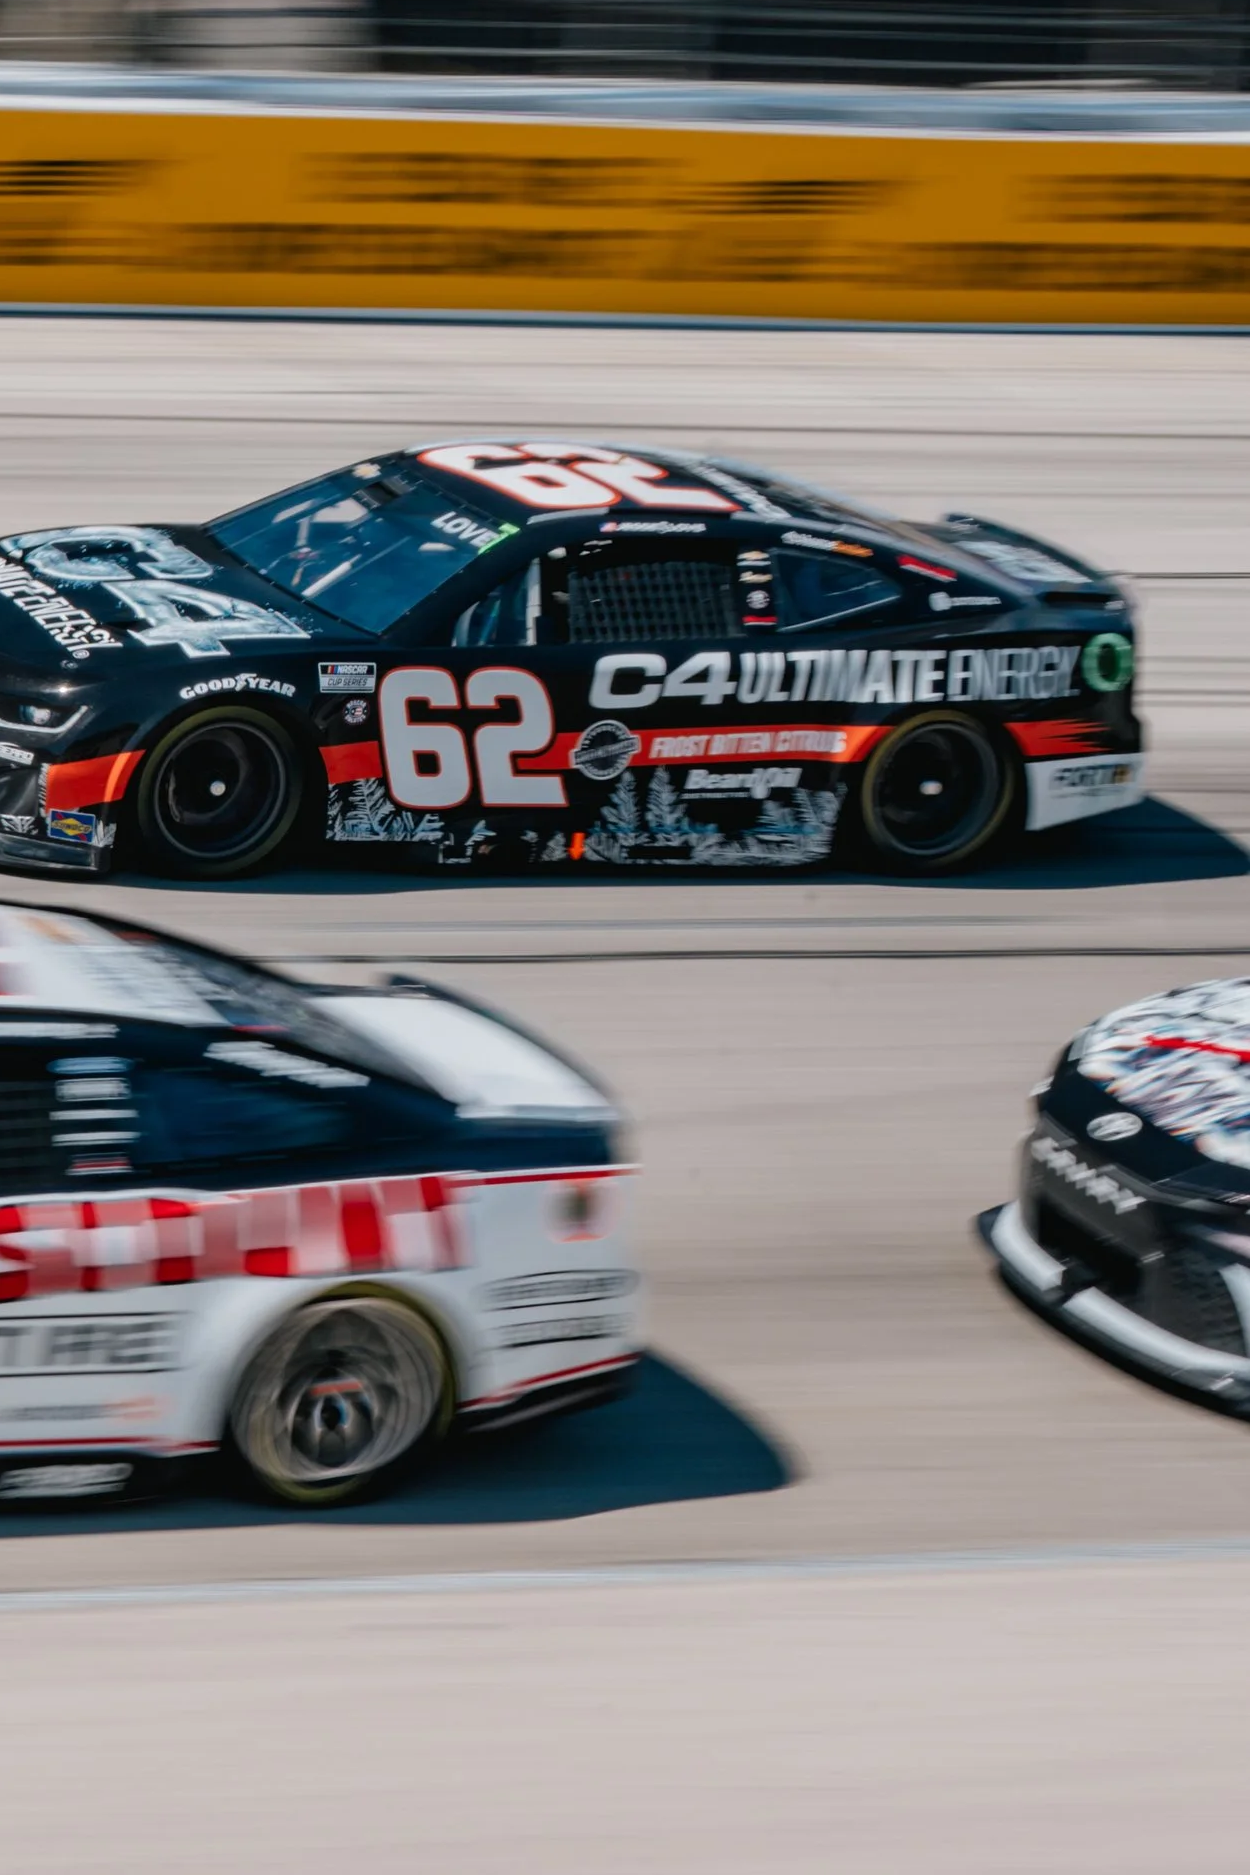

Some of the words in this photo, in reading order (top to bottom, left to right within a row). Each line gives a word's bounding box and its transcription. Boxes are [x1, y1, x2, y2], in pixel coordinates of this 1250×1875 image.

[416, 441, 743, 512] 62
[327, 677, 342, 686] CUP
[343, 677, 368, 687] SERIES
[335, 664, 369, 675] NASCAR
[589, 652, 738, 708] C4
[737, 649, 946, 704] ULTIMATE
[378, 666, 570, 810] 62
[649, 736, 711, 759] FROST
